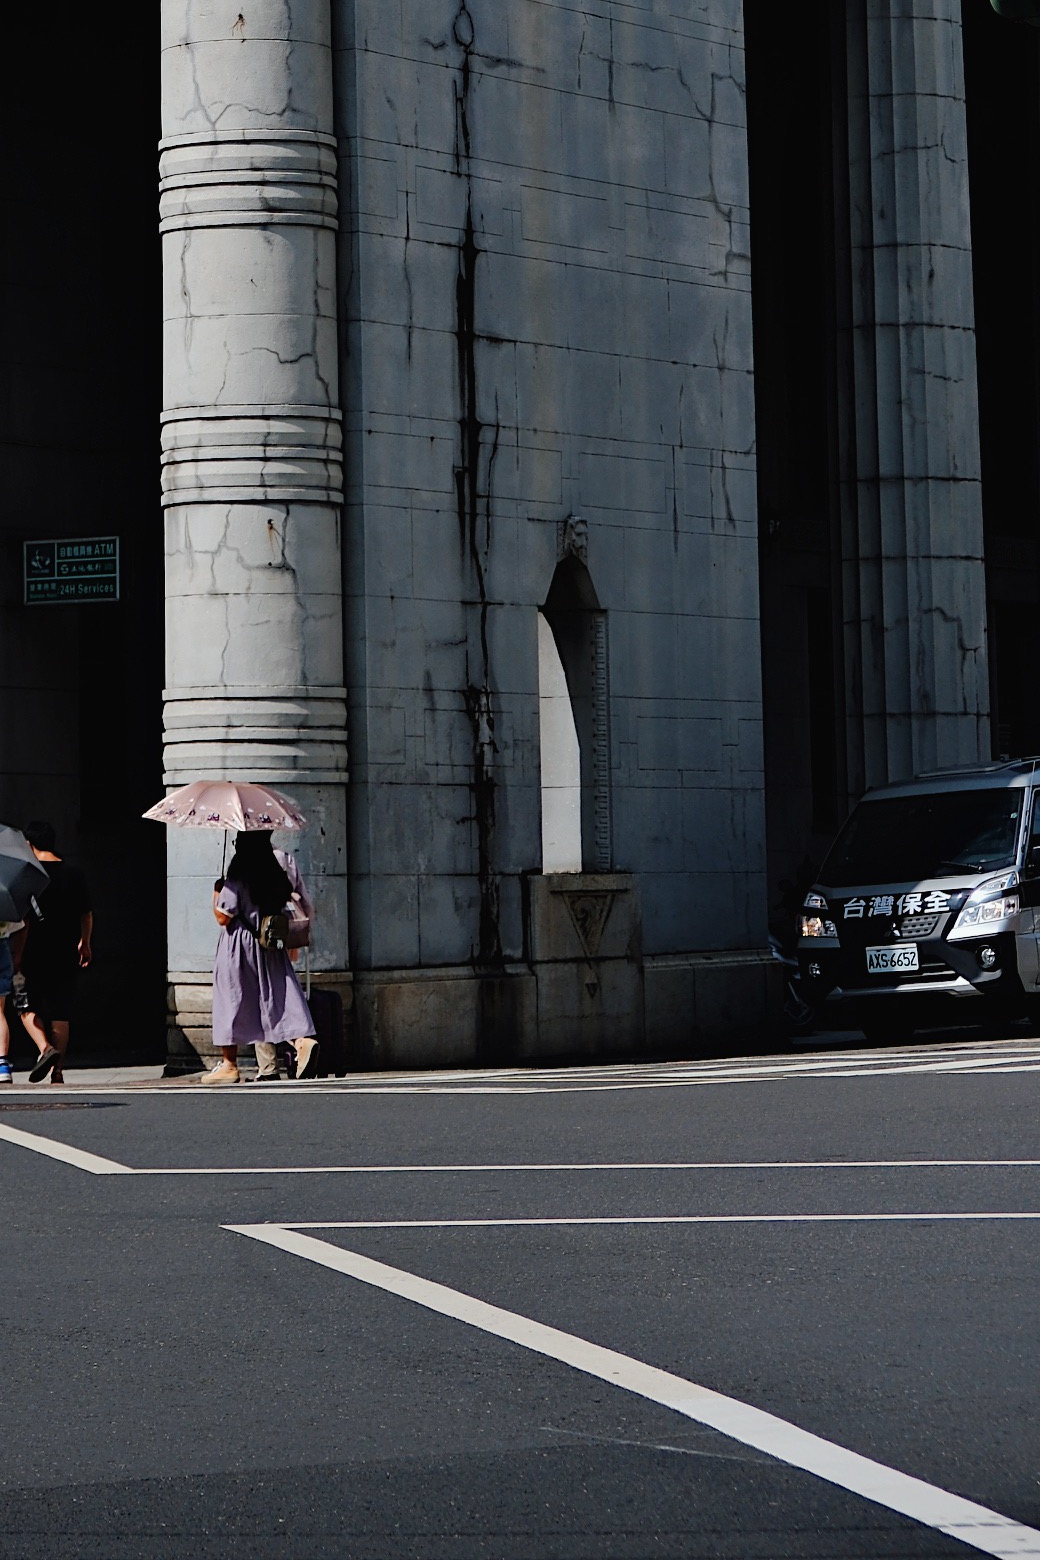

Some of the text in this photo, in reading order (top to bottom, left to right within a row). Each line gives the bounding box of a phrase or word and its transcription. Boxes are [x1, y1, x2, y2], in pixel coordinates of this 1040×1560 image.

[93, 543, 114, 555] ATM
[77, 583, 114, 594] Services
[843, 890, 952, 919] 台灣保全
